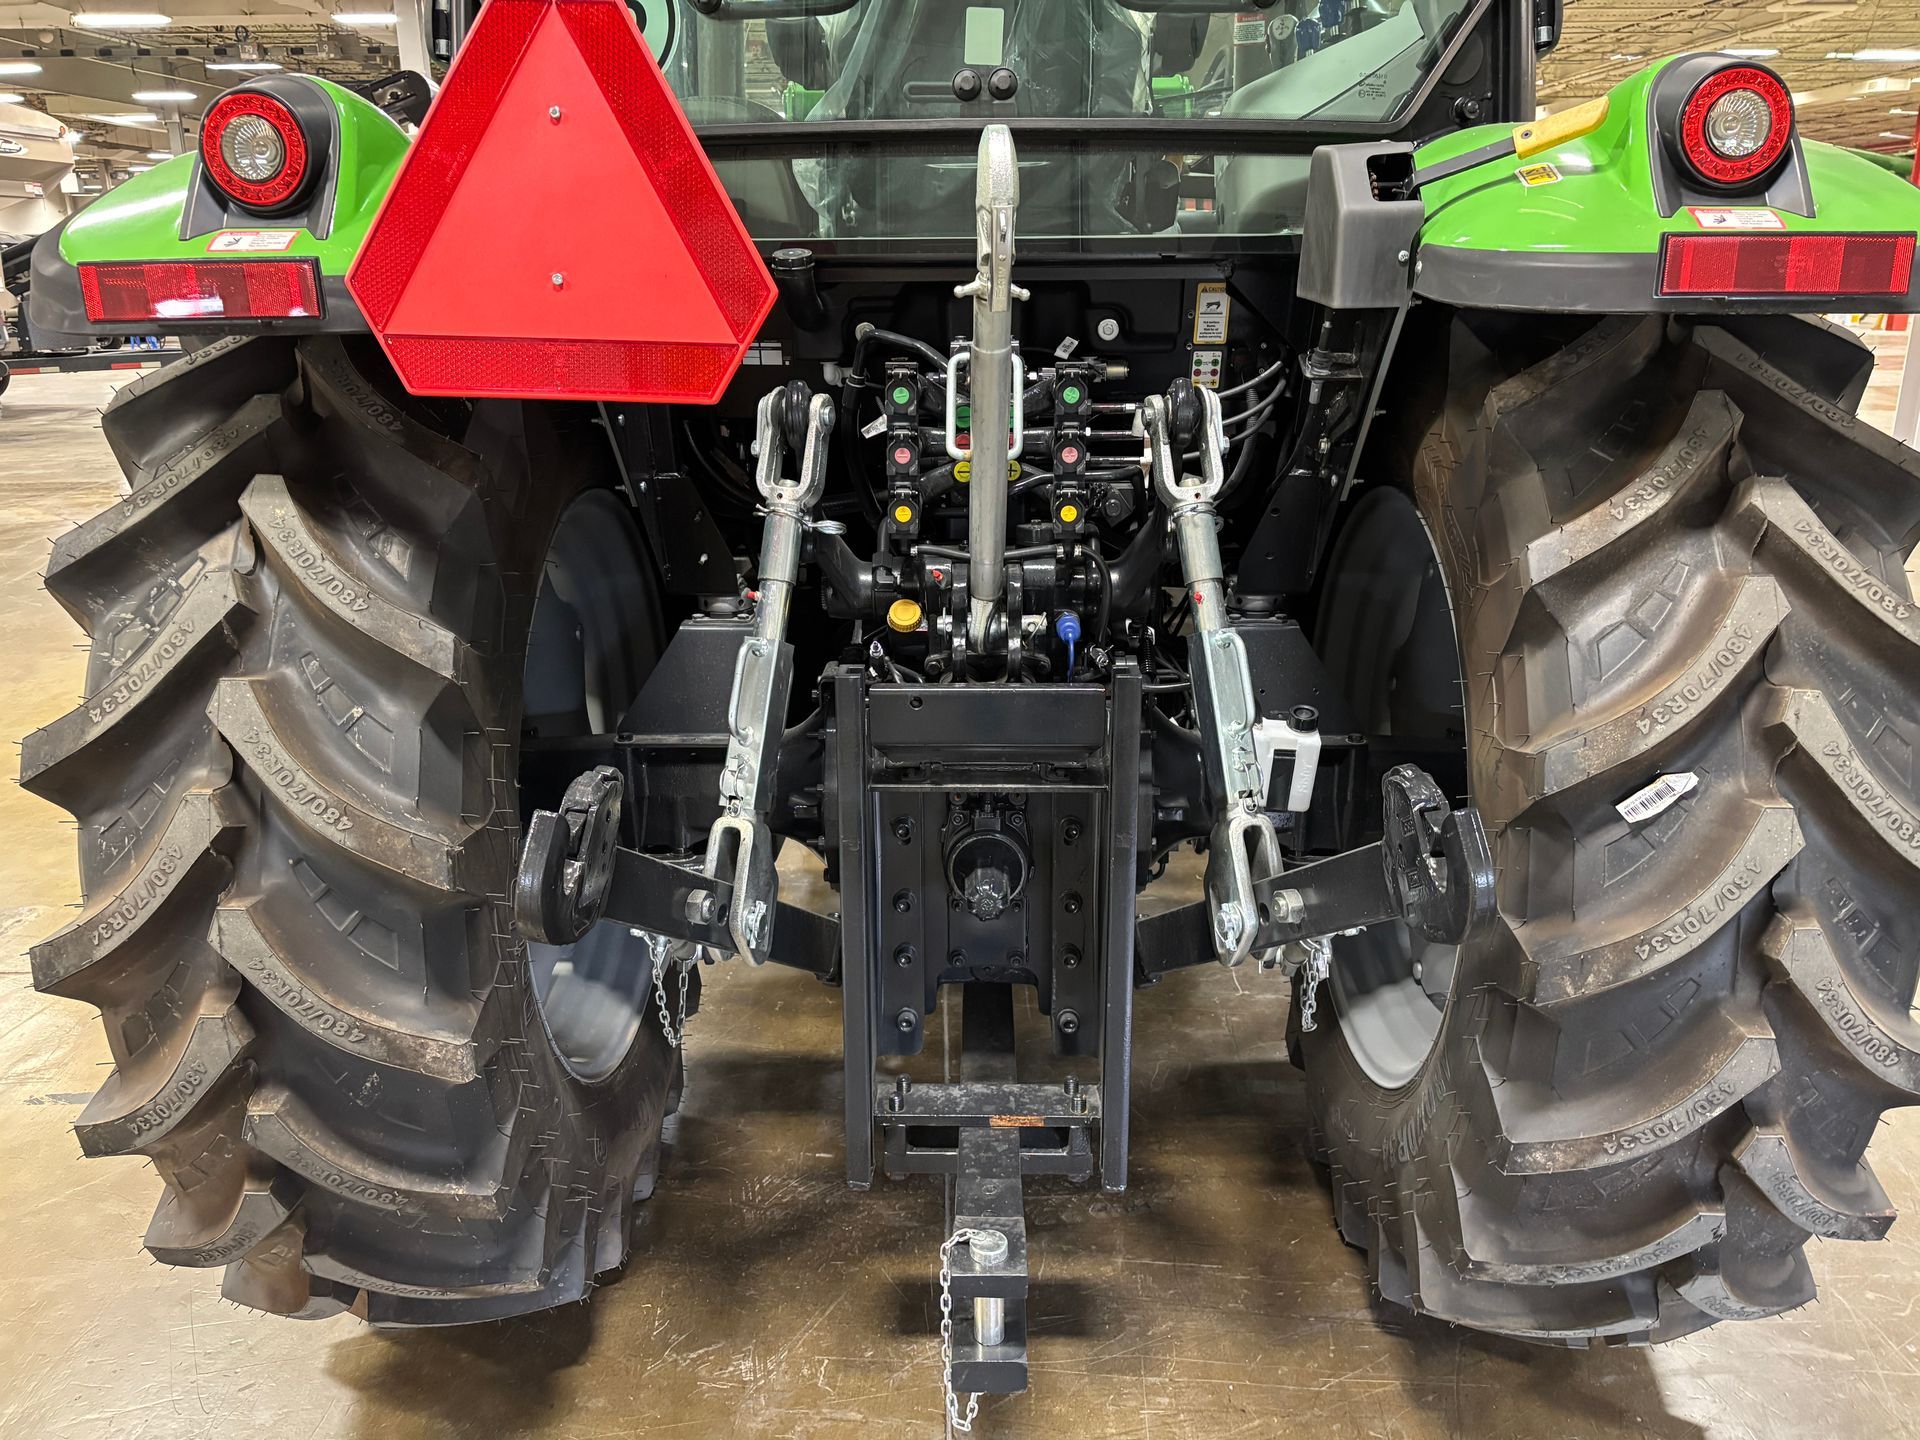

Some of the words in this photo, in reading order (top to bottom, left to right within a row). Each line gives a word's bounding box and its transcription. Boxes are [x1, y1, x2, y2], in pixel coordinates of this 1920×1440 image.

[1610, 425, 1710, 522] 480/70R34
[269, 517, 369, 614] 480/70R34
[1794, 520, 1911, 621] 480/70R34
[88, 618, 195, 725] 480/70R34
[1635, 622, 1754, 736] 480/70R34
[242, 729, 354, 832] 480/70R34
[90, 843, 184, 947] 480/70R34
[1634, 858, 1763, 961] 480/70R34
[247, 956, 367, 1045] 480/70R34
[1814, 974, 1901, 1069] 480/70R34
[126, 1060, 208, 1136] 480/70R34
[1600, 1077, 1737, 1156] 480/70R34
